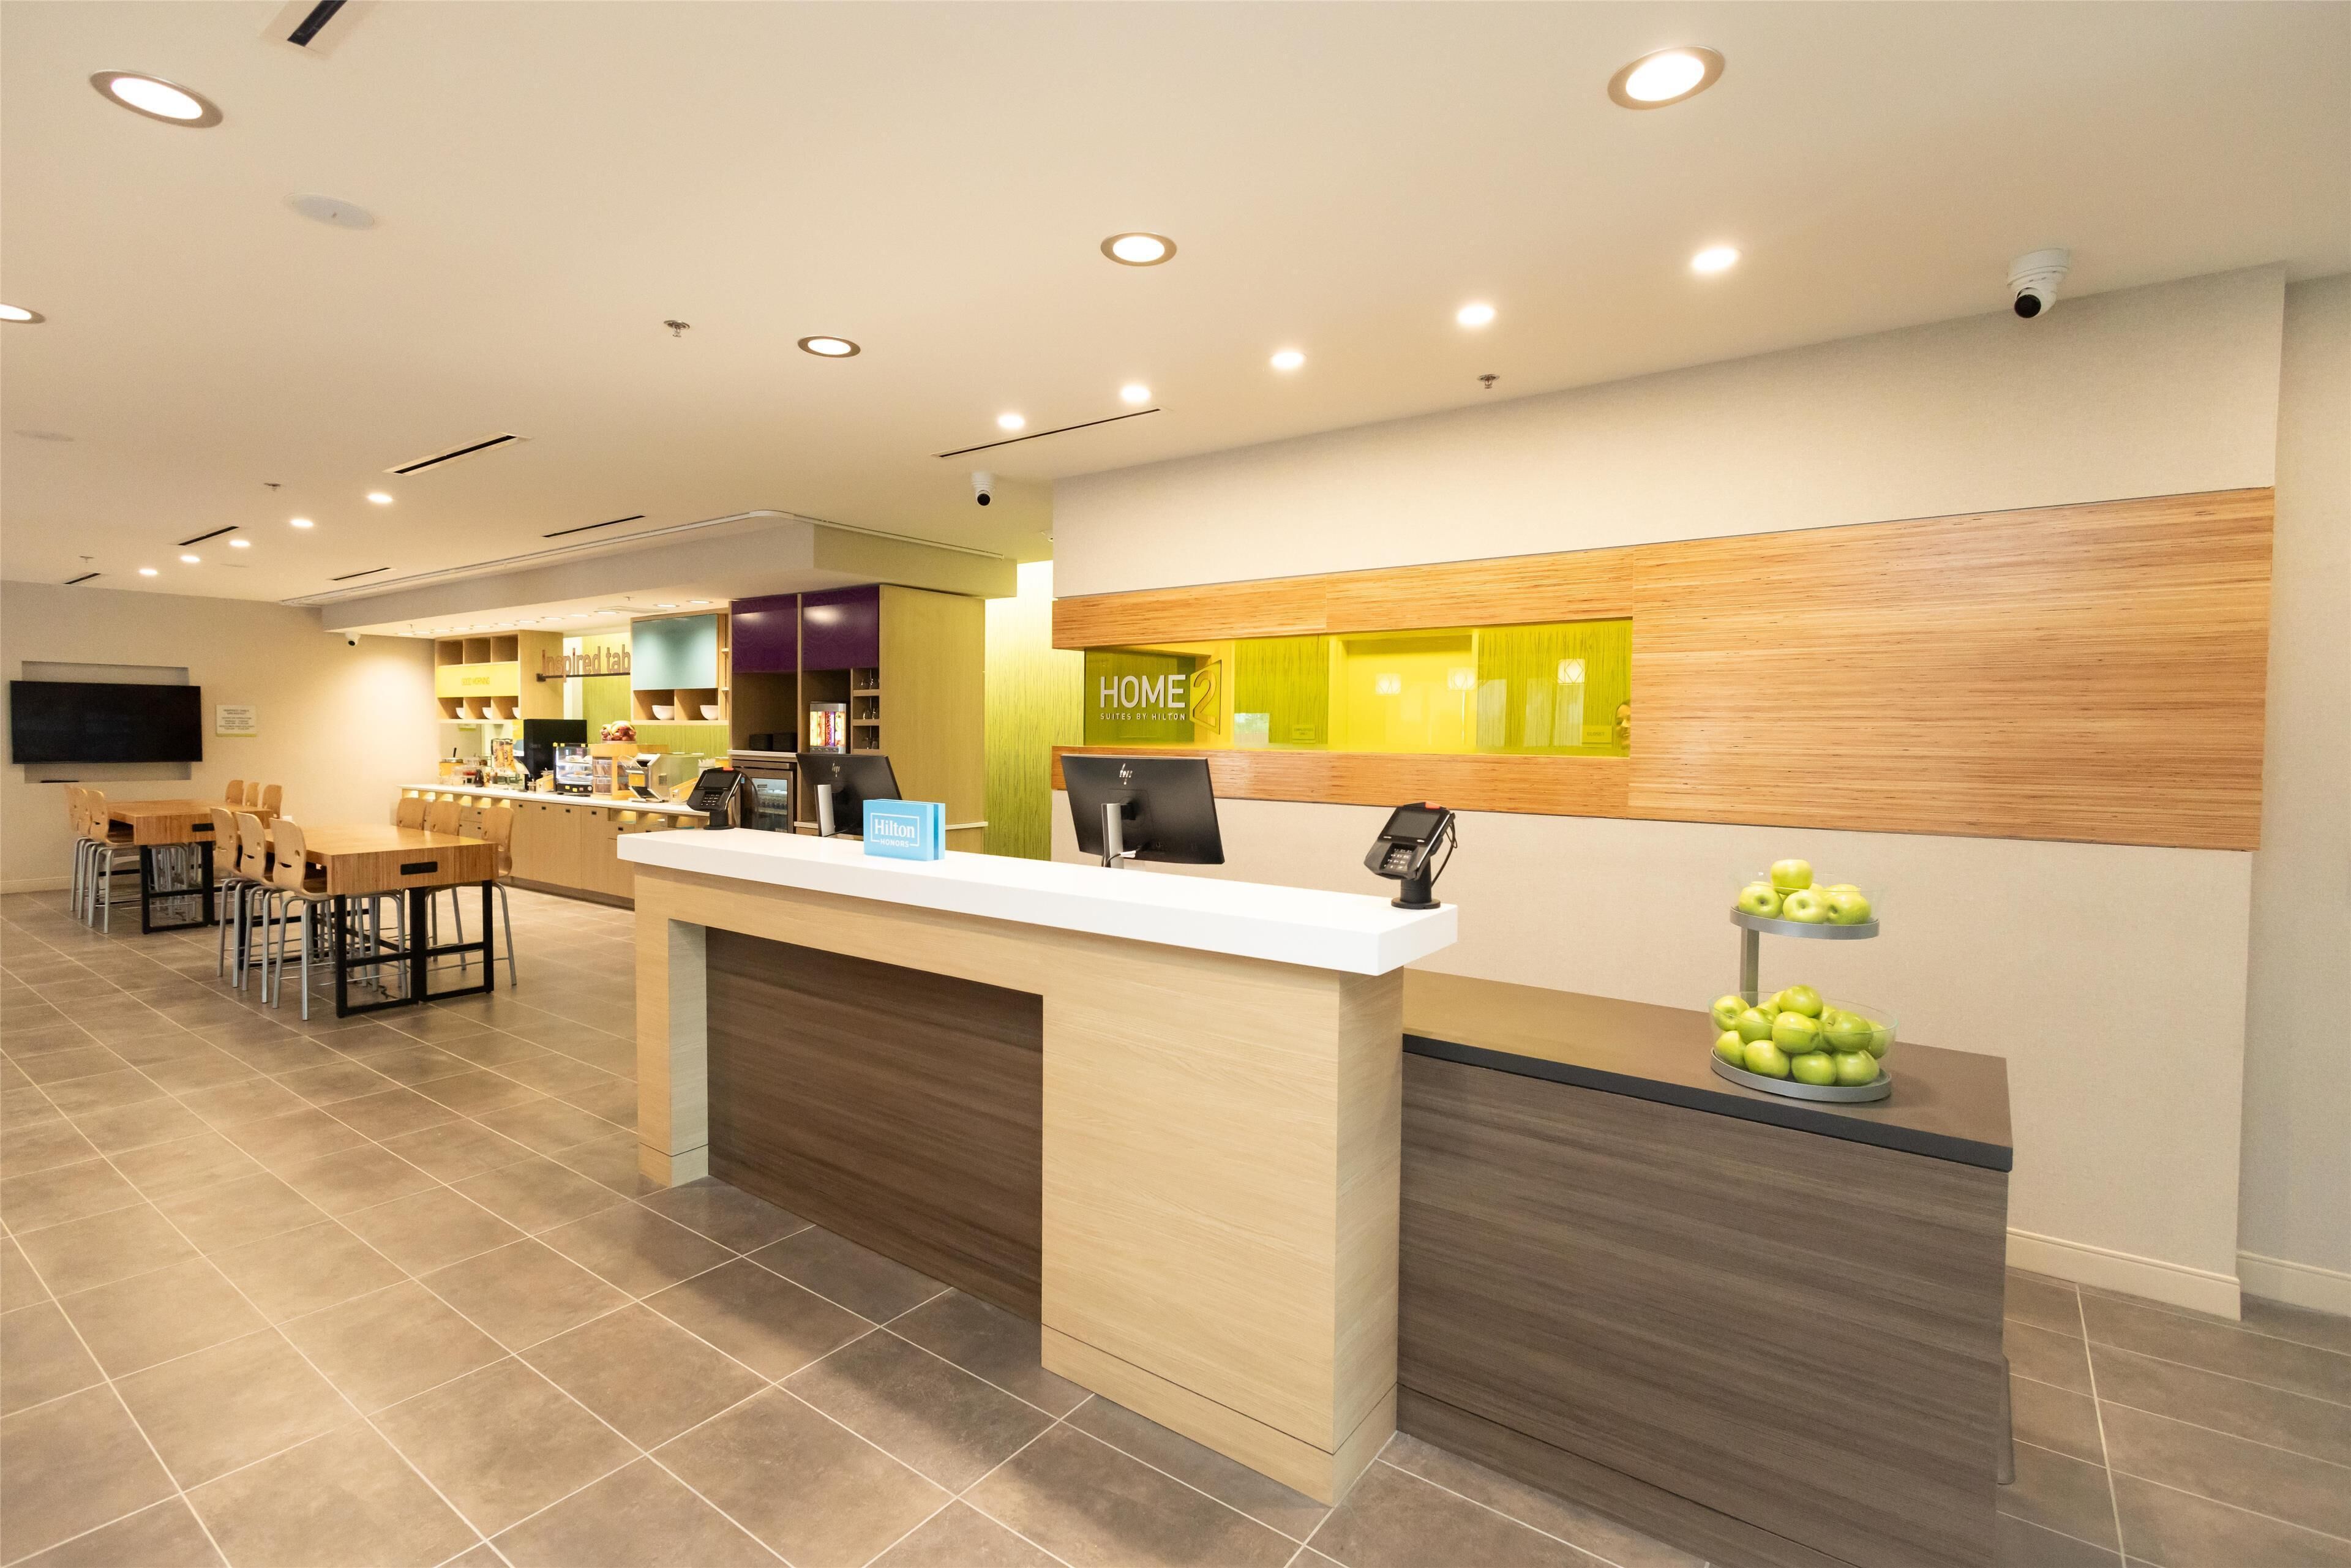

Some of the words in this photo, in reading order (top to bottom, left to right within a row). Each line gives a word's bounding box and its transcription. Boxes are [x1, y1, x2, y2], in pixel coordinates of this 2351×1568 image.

[1100, 674, 1186, 708] HOME
[1192, 670, 1217, 729] 2
[1152, 713, 1186, 721] HILTON
[1119, 763, 1133, 785] hp
[874, 819, 915, 838] Hilton
[880, 839, 909, 847] HONORS
